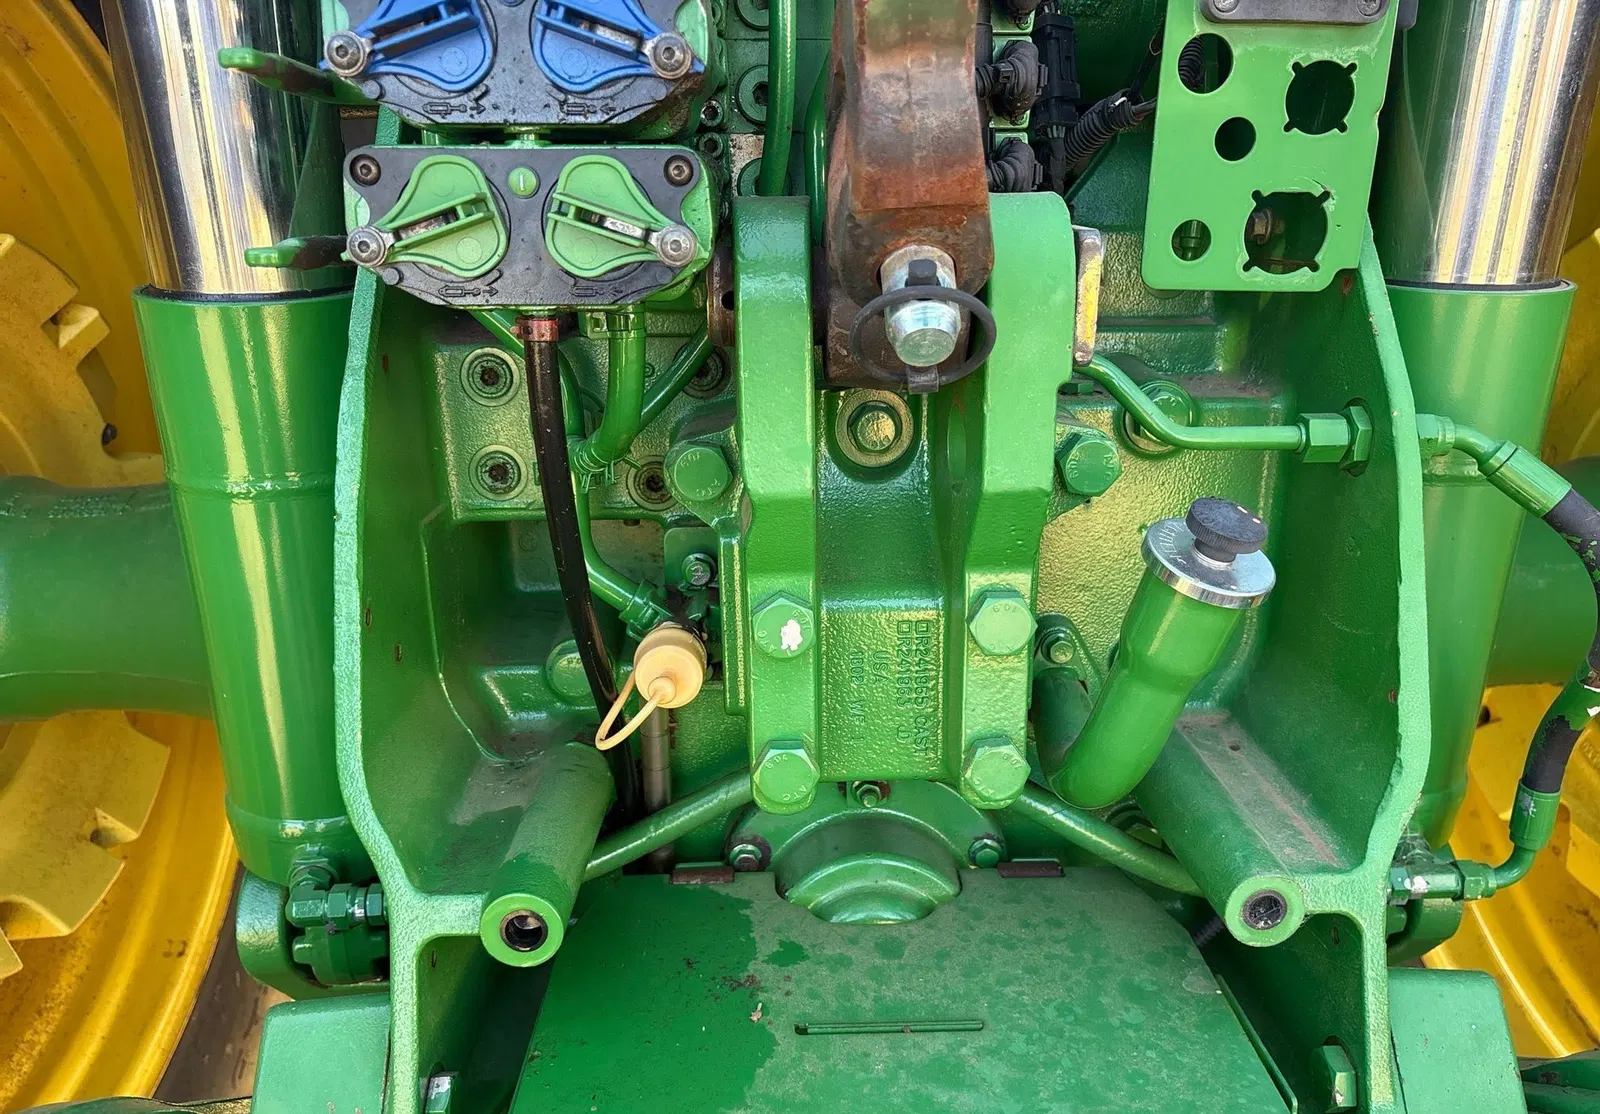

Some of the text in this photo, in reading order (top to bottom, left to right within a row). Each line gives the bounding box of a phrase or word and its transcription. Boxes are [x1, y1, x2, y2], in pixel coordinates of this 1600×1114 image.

[872, 650, 889, 686] USA
[896, 636, 912, 708] R241963
[914, 636, 930, 757] R241965 CAST
